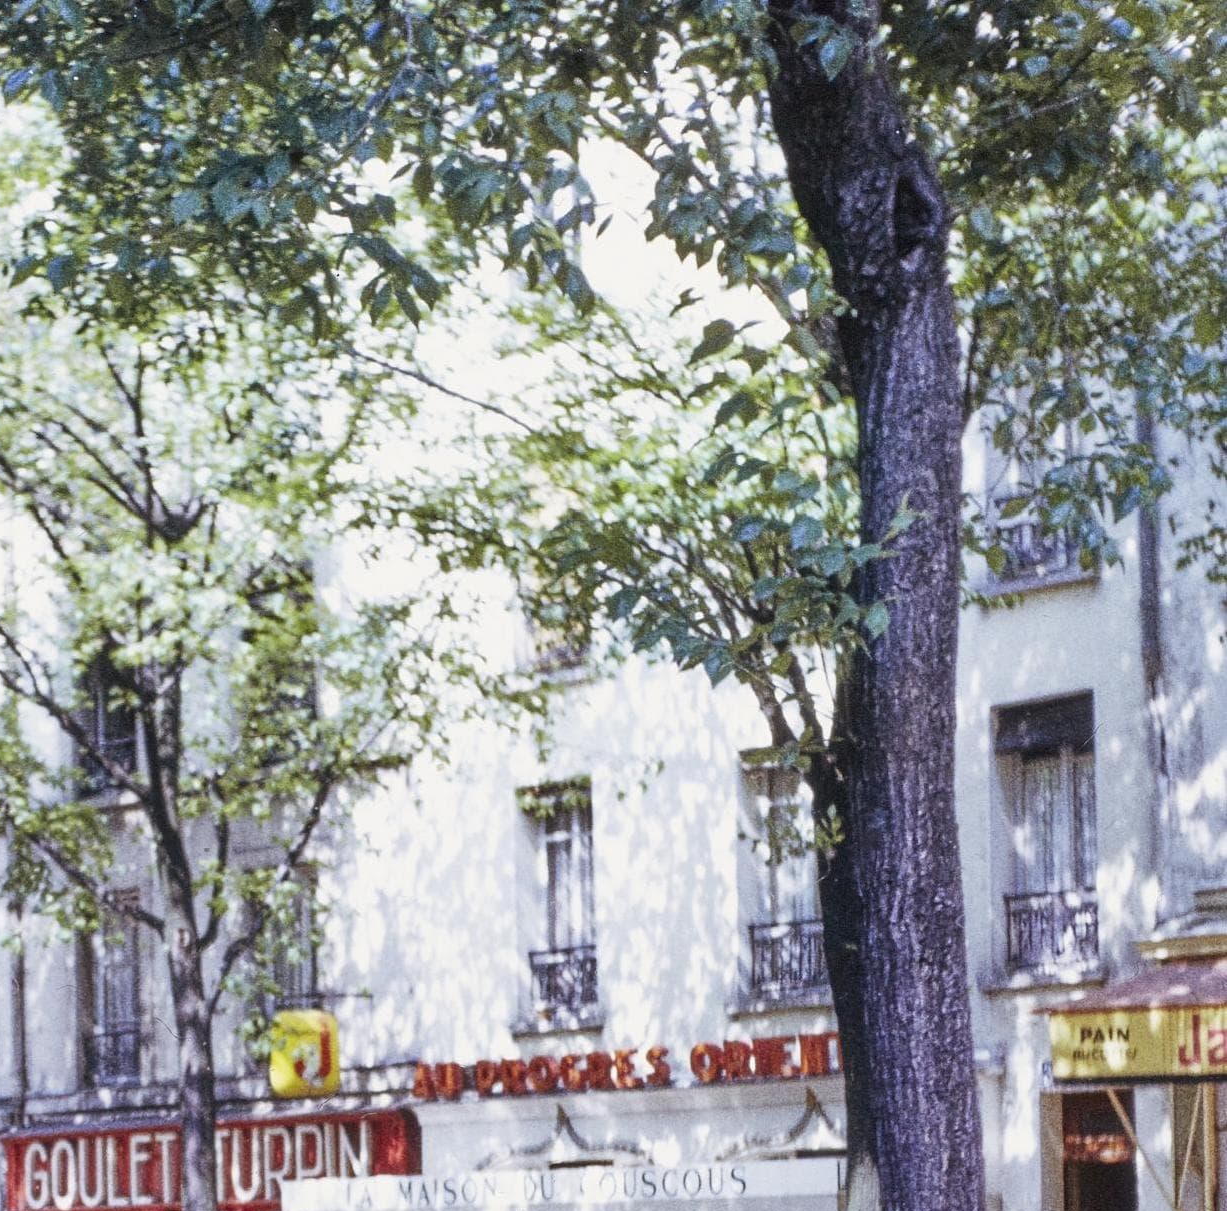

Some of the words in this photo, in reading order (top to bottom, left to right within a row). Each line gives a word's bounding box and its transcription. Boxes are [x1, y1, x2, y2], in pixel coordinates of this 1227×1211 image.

[1079, 1025, 1130, 1043] PAIN
[412, 1061, 463, 1101] AU
[24, 1131, 177, 1211] GOULET
[214, 1119, 369, 1204] TURPIN
[398, 1174, 499, 1206] MAISON
[523, 1172, 555, 1201] DU
[579, 1165, 747, 1199] COUSCOUS
